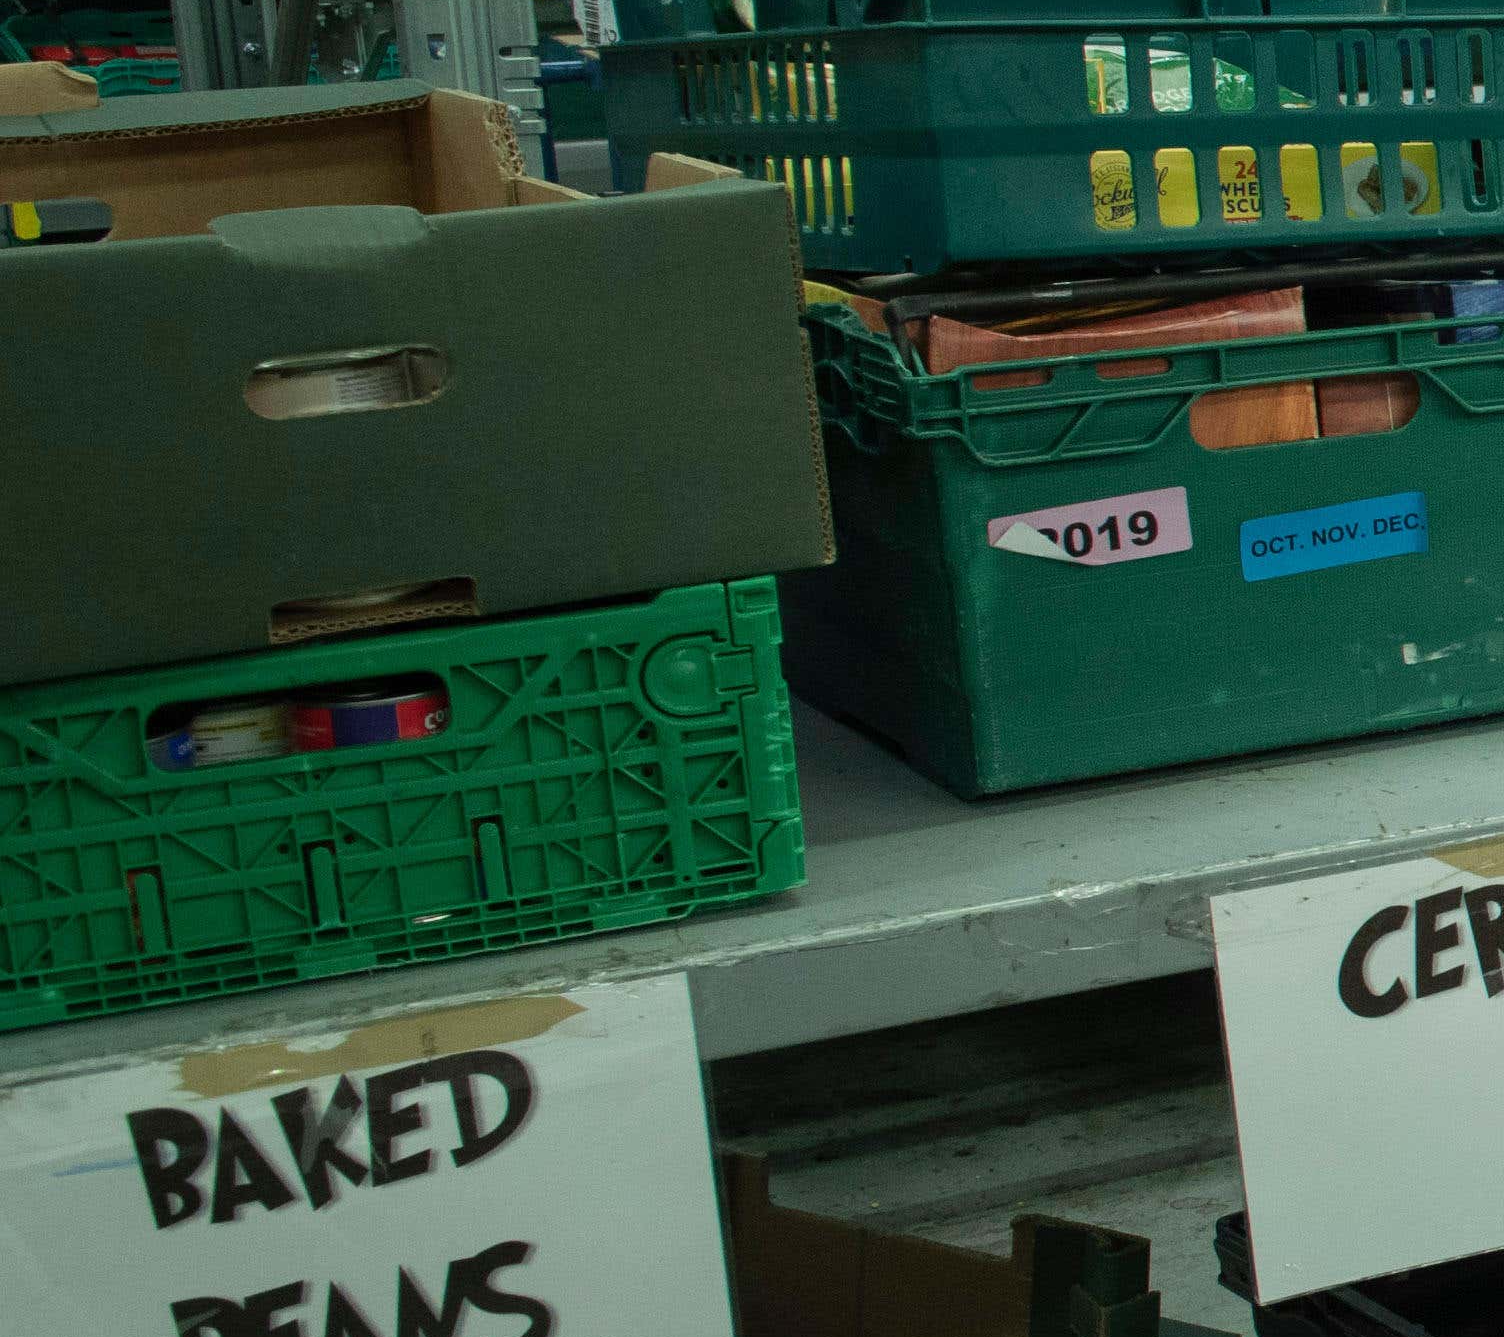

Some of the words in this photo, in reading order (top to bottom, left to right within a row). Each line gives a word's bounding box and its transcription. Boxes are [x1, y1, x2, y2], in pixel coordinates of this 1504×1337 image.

[1037, 510, 1160, 559] 019
[1250, 535, 1305, 558] OCT.
[1312, 525, 1366, 547] NOV.
[1373, 513, 1427, 536] DEC.
[126, 1049, 537, 1230] BAKED
